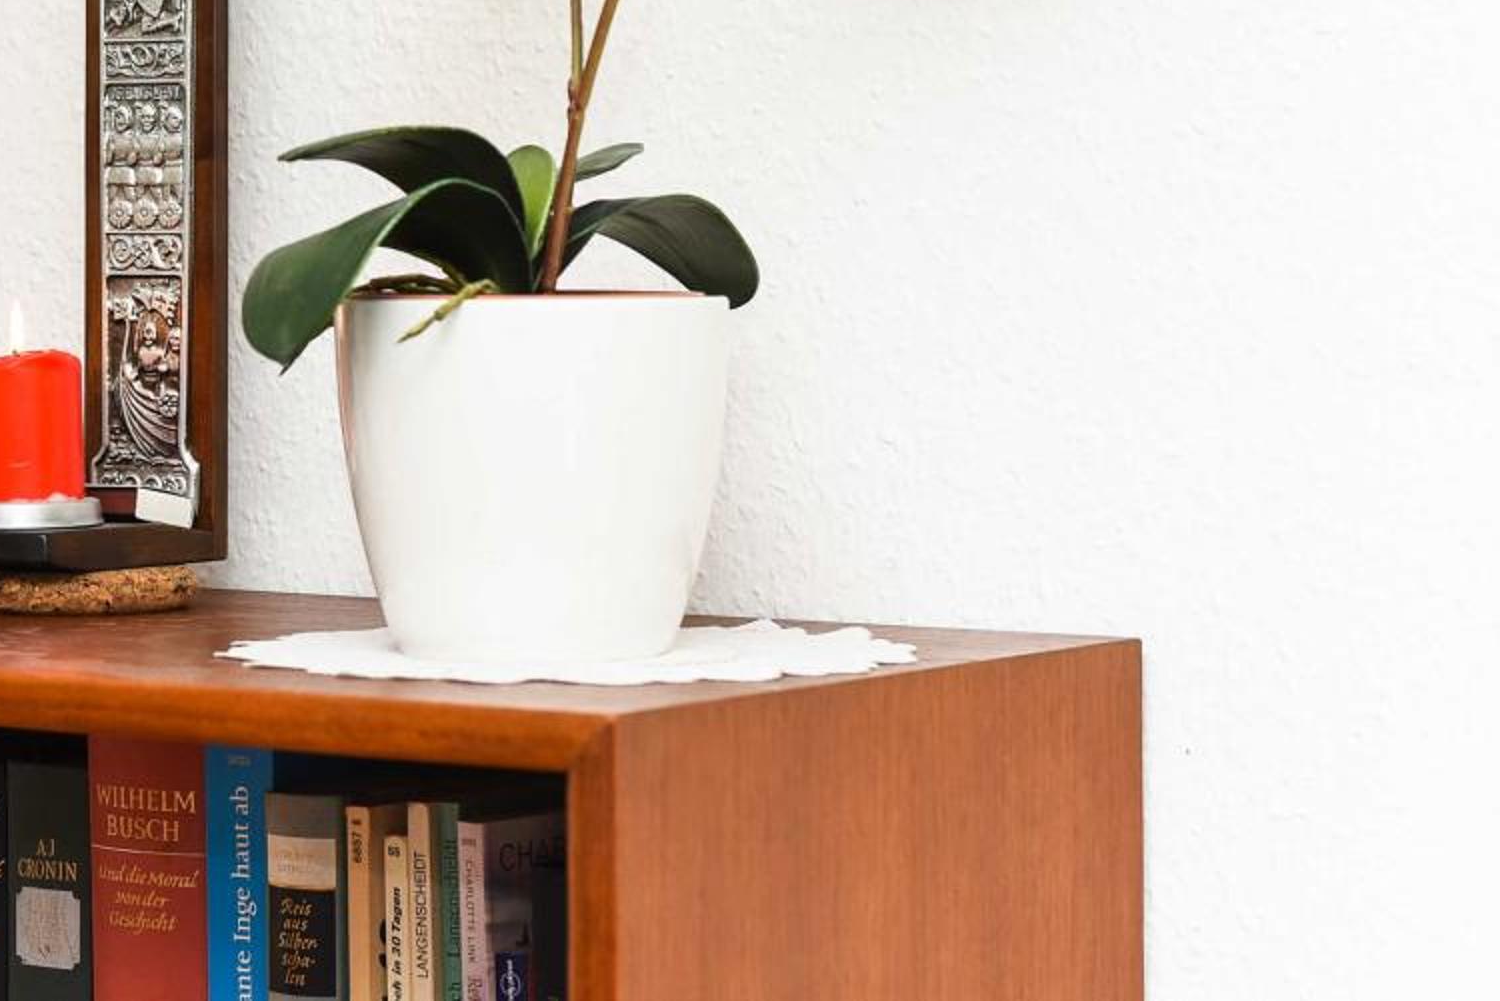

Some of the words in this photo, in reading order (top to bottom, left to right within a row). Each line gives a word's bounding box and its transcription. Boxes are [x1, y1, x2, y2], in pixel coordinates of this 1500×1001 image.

[96, 783, 196, 814] WILHELM
[229, 786, 249, 815] ab
[107, 814, 179, 842] BUSCH
[230, 823, 251, 880] haut
[17, 857, 78, 882] CRONIN
[99, 863, 125, 883] Und
[125, 865, 148, 885] die
[148, 870, 200, 888] Moral
[115, 891, 141, 905] von
[281, 897, 312, 917] Reis
[391, 887, 402, 932] Tagen
[465, 860, 476, 931] CHARLOTTE
[233, 887, 257, 942] Inge
[283, 918, 308, 932] aus
[413, 850, 428, 979] LANGENSCHEIDT
[392, 937, 401, 957] 30
[467, 936, 477, 963] LINK
[236, 950, 252, 1001] ante
[391, 960, 402, 976] in
